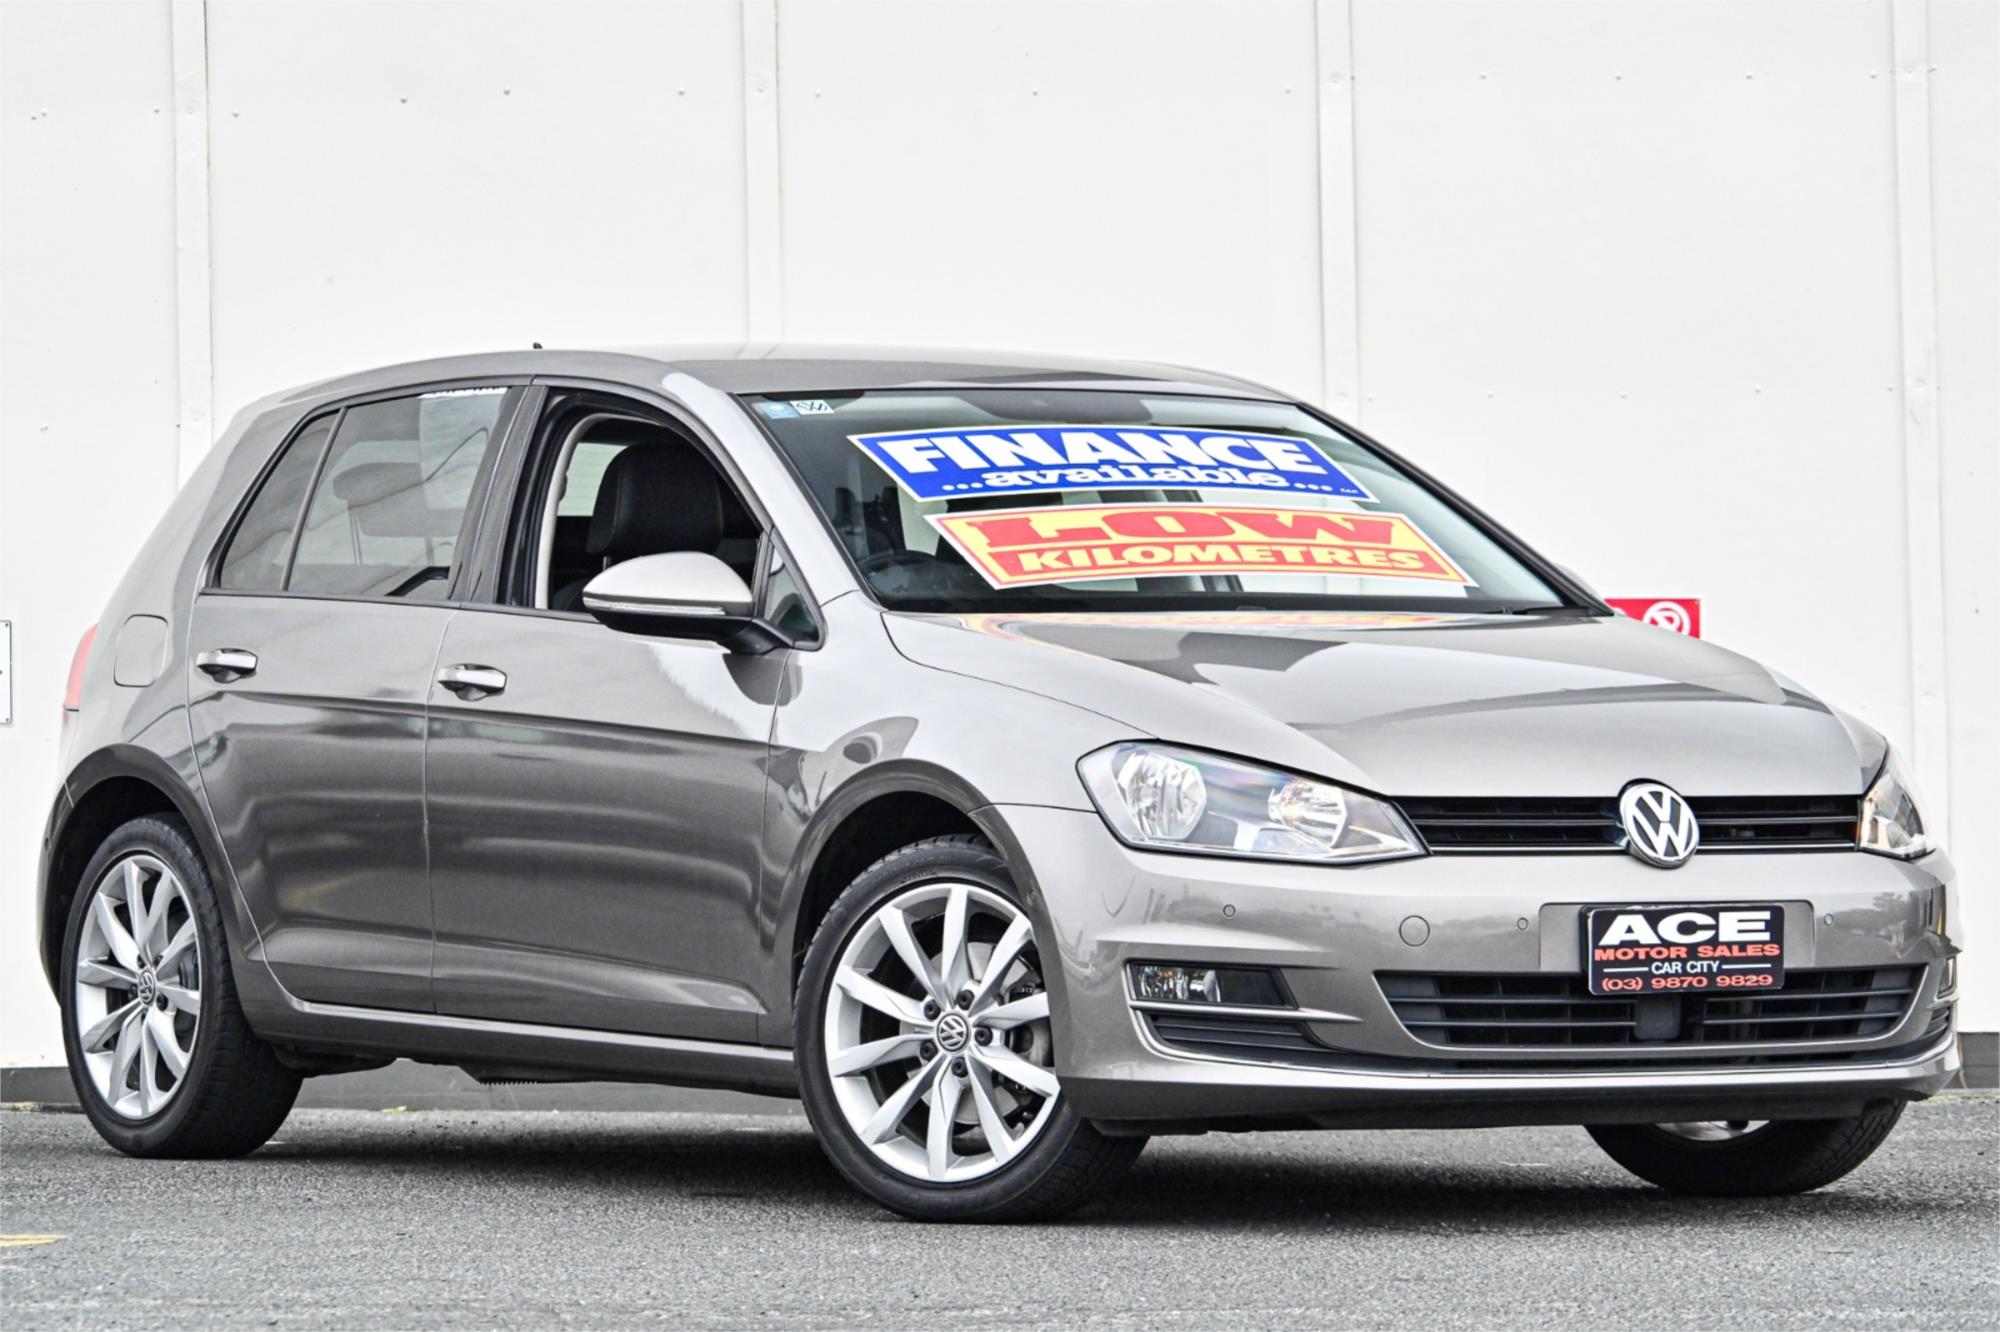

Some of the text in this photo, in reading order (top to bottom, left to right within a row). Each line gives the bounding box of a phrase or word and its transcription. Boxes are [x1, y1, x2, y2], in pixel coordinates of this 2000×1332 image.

[877, 432, 1328, 475] FINANCE
[966, 511, 1394, 547] LOW
[1017, 544, 1425, 571] KILOMETRES
[1598, 911, 1771, 945] ACE
[1594, 944, 1780, 961] MOTOR SALES
[1651, 960, 1720, 974] CAR CITY
[1602, 974, 1773, 991] (03) 9870 9829
